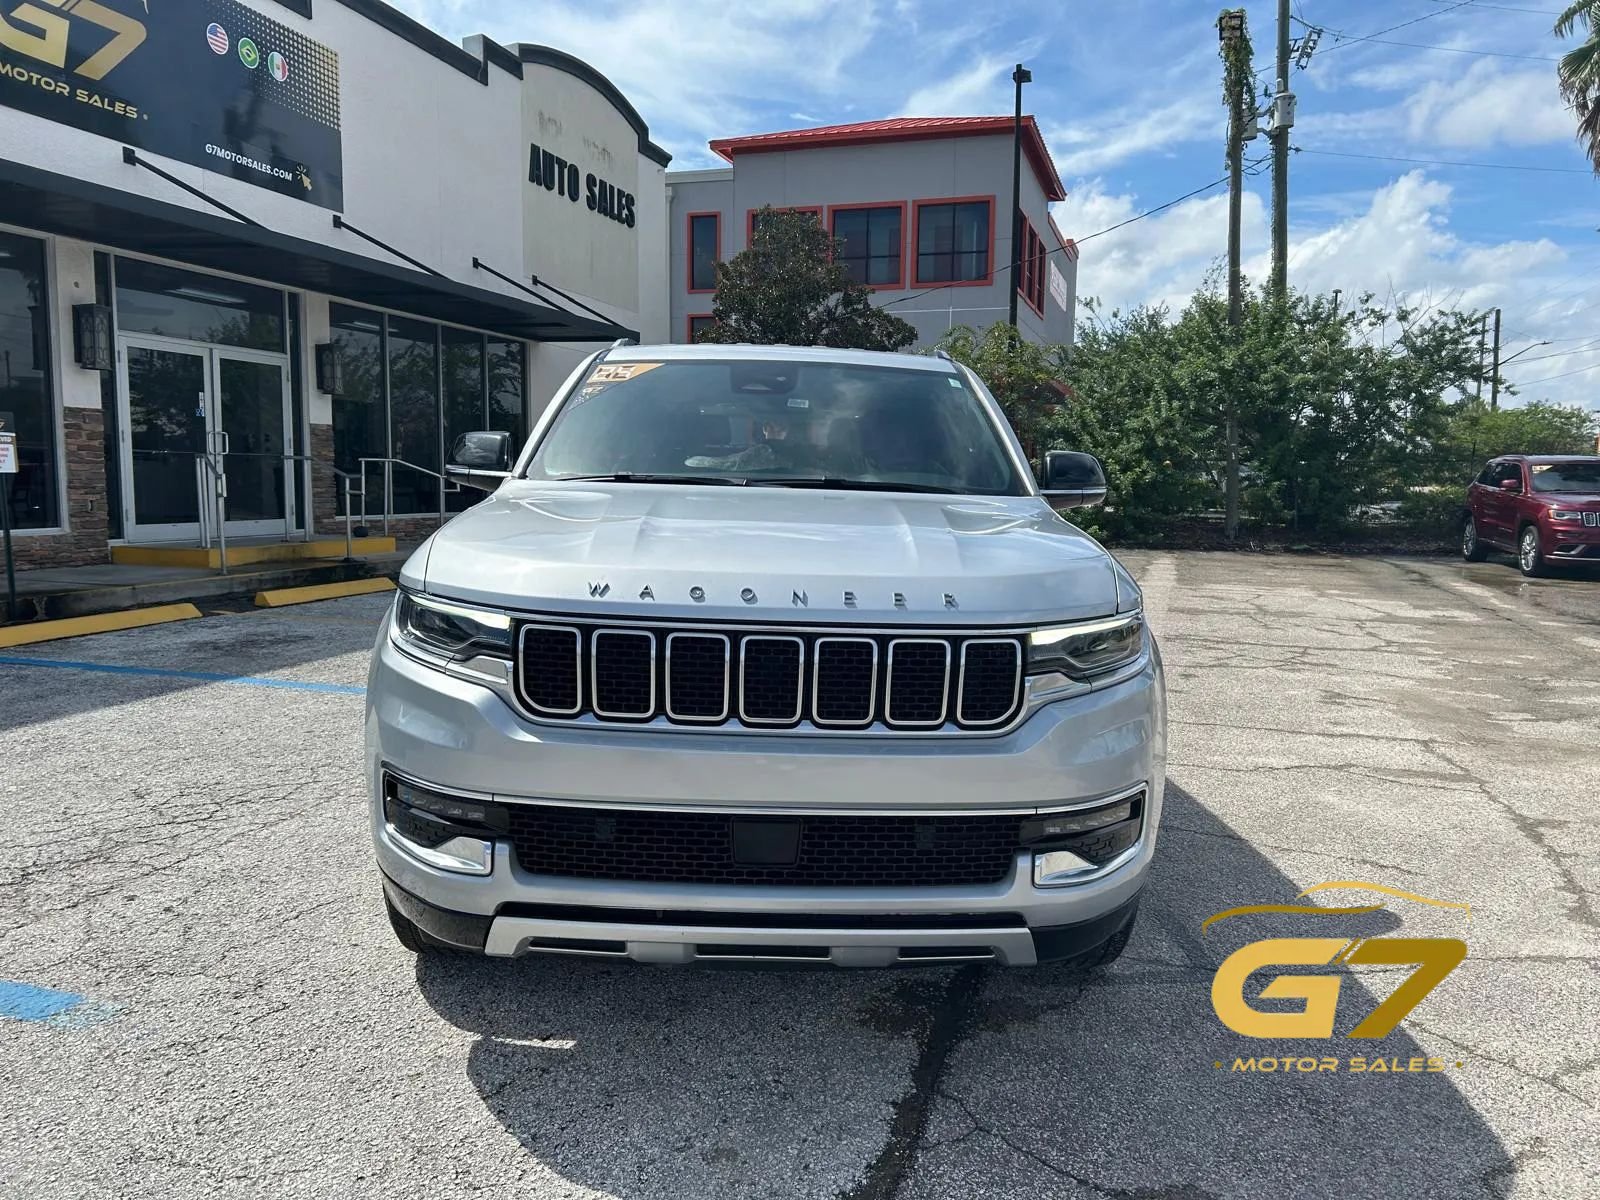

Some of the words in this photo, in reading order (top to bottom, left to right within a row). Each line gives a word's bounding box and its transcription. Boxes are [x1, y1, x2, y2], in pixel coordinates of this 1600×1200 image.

[0, 0, 147, 80] G7
[0, 62, 70, 97] MOTOR
[75, 88, 139, 119] SALES
[205, 143, 293, 181] G7MOTORSALES.COM
[528, 142, 580, 203] AUTO
[585, 172, 636, 229] SALES
[587, 580, 960, 610] WAGONEER
